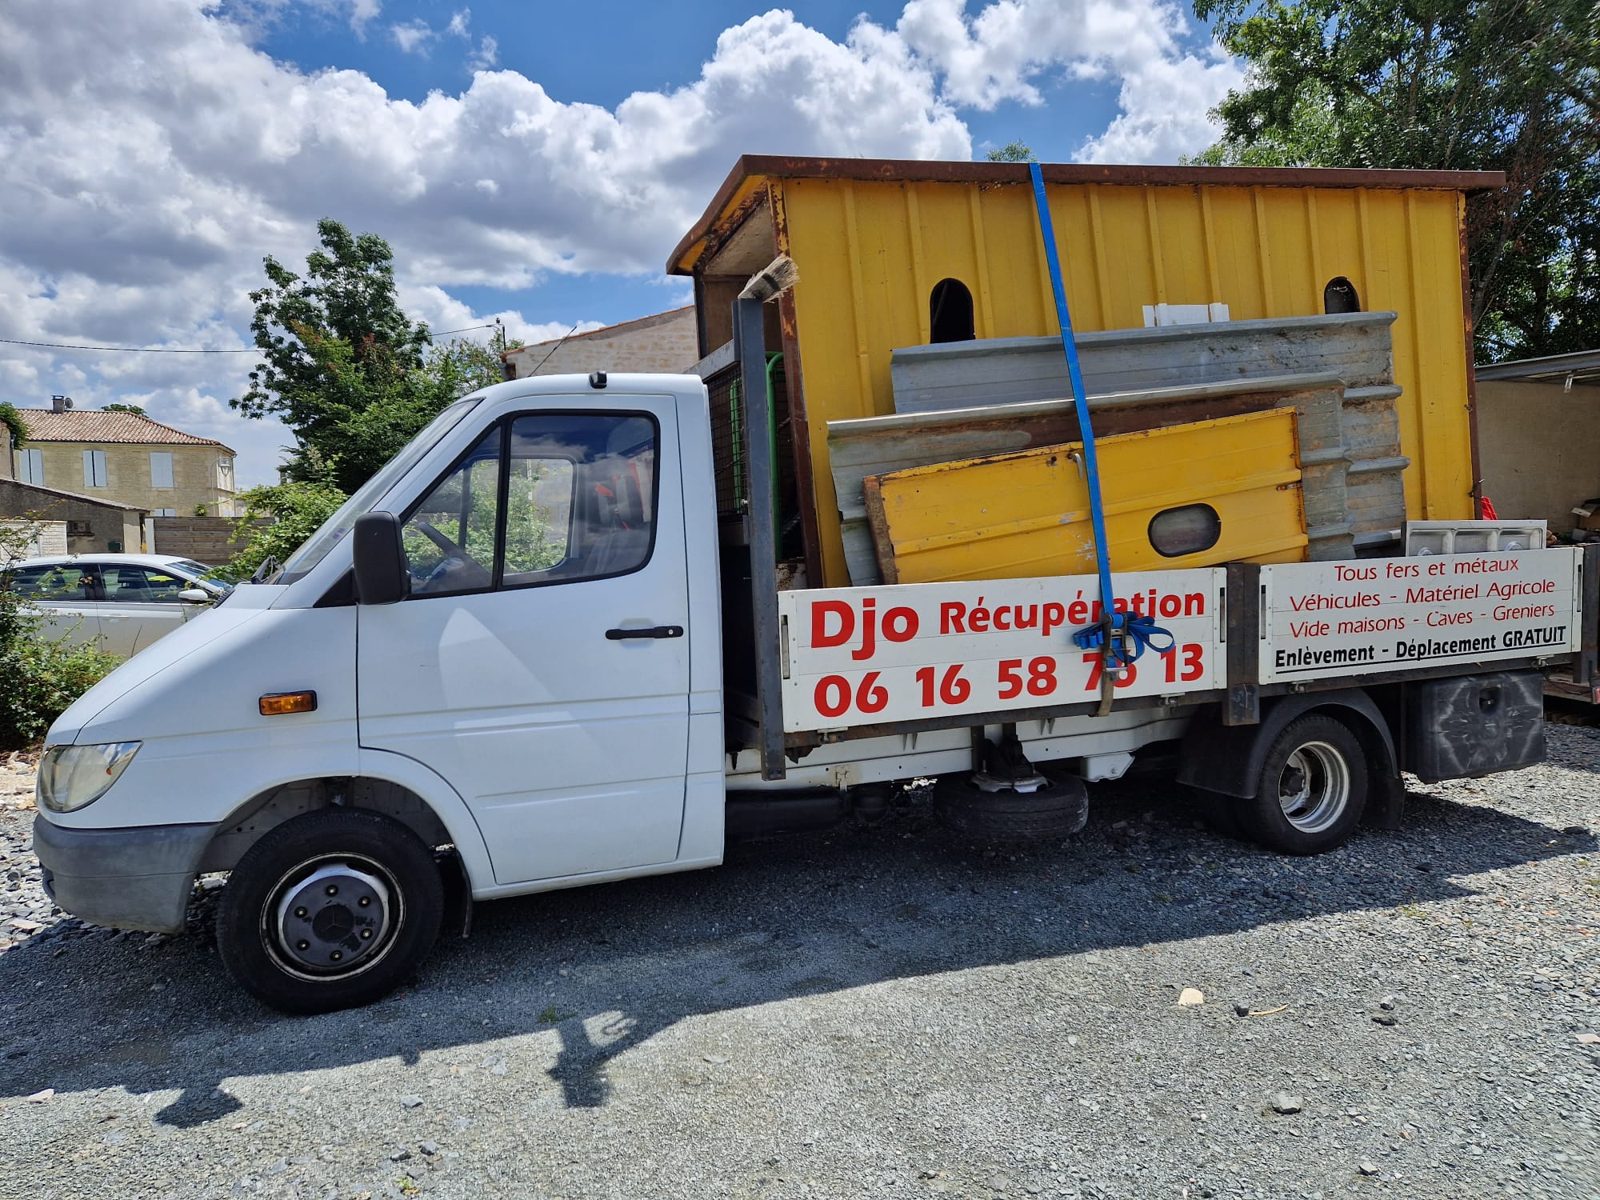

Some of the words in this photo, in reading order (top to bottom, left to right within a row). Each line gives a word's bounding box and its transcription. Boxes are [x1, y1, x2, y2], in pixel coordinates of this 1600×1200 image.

[1334, 564, 1377, 582] Tous
[1386, 562, 1419, 579] fers
[1428, 560, 1446, 576] et
[1454, 556, 1519, 575] métaux
[1289, 591, 1381, 612] Véhicules
[1405, 584, 1479, 604] Matériel
[1487, 578, 1555, 601] Agricole
[811, 598, 919, 661] Djo
[1289, 620, 1330, 638] Vide
[1337, 616, 1405, 635] maisons
[1426, 611, 1473, 627] Caves
[1493, 604, 1555, 621] Greniers
[1275, 645, 1375, 667] Enlèvement
[1396, 634, 1497, 660] Déplacement
[1502, 626, 1566, 648] GRATUIT
[813, 671, 889, 719] 06
[916, 664, 971, 708] 16
[998, 655, 1057, 700] 58
[1160, 643, 1205, 684] 13
